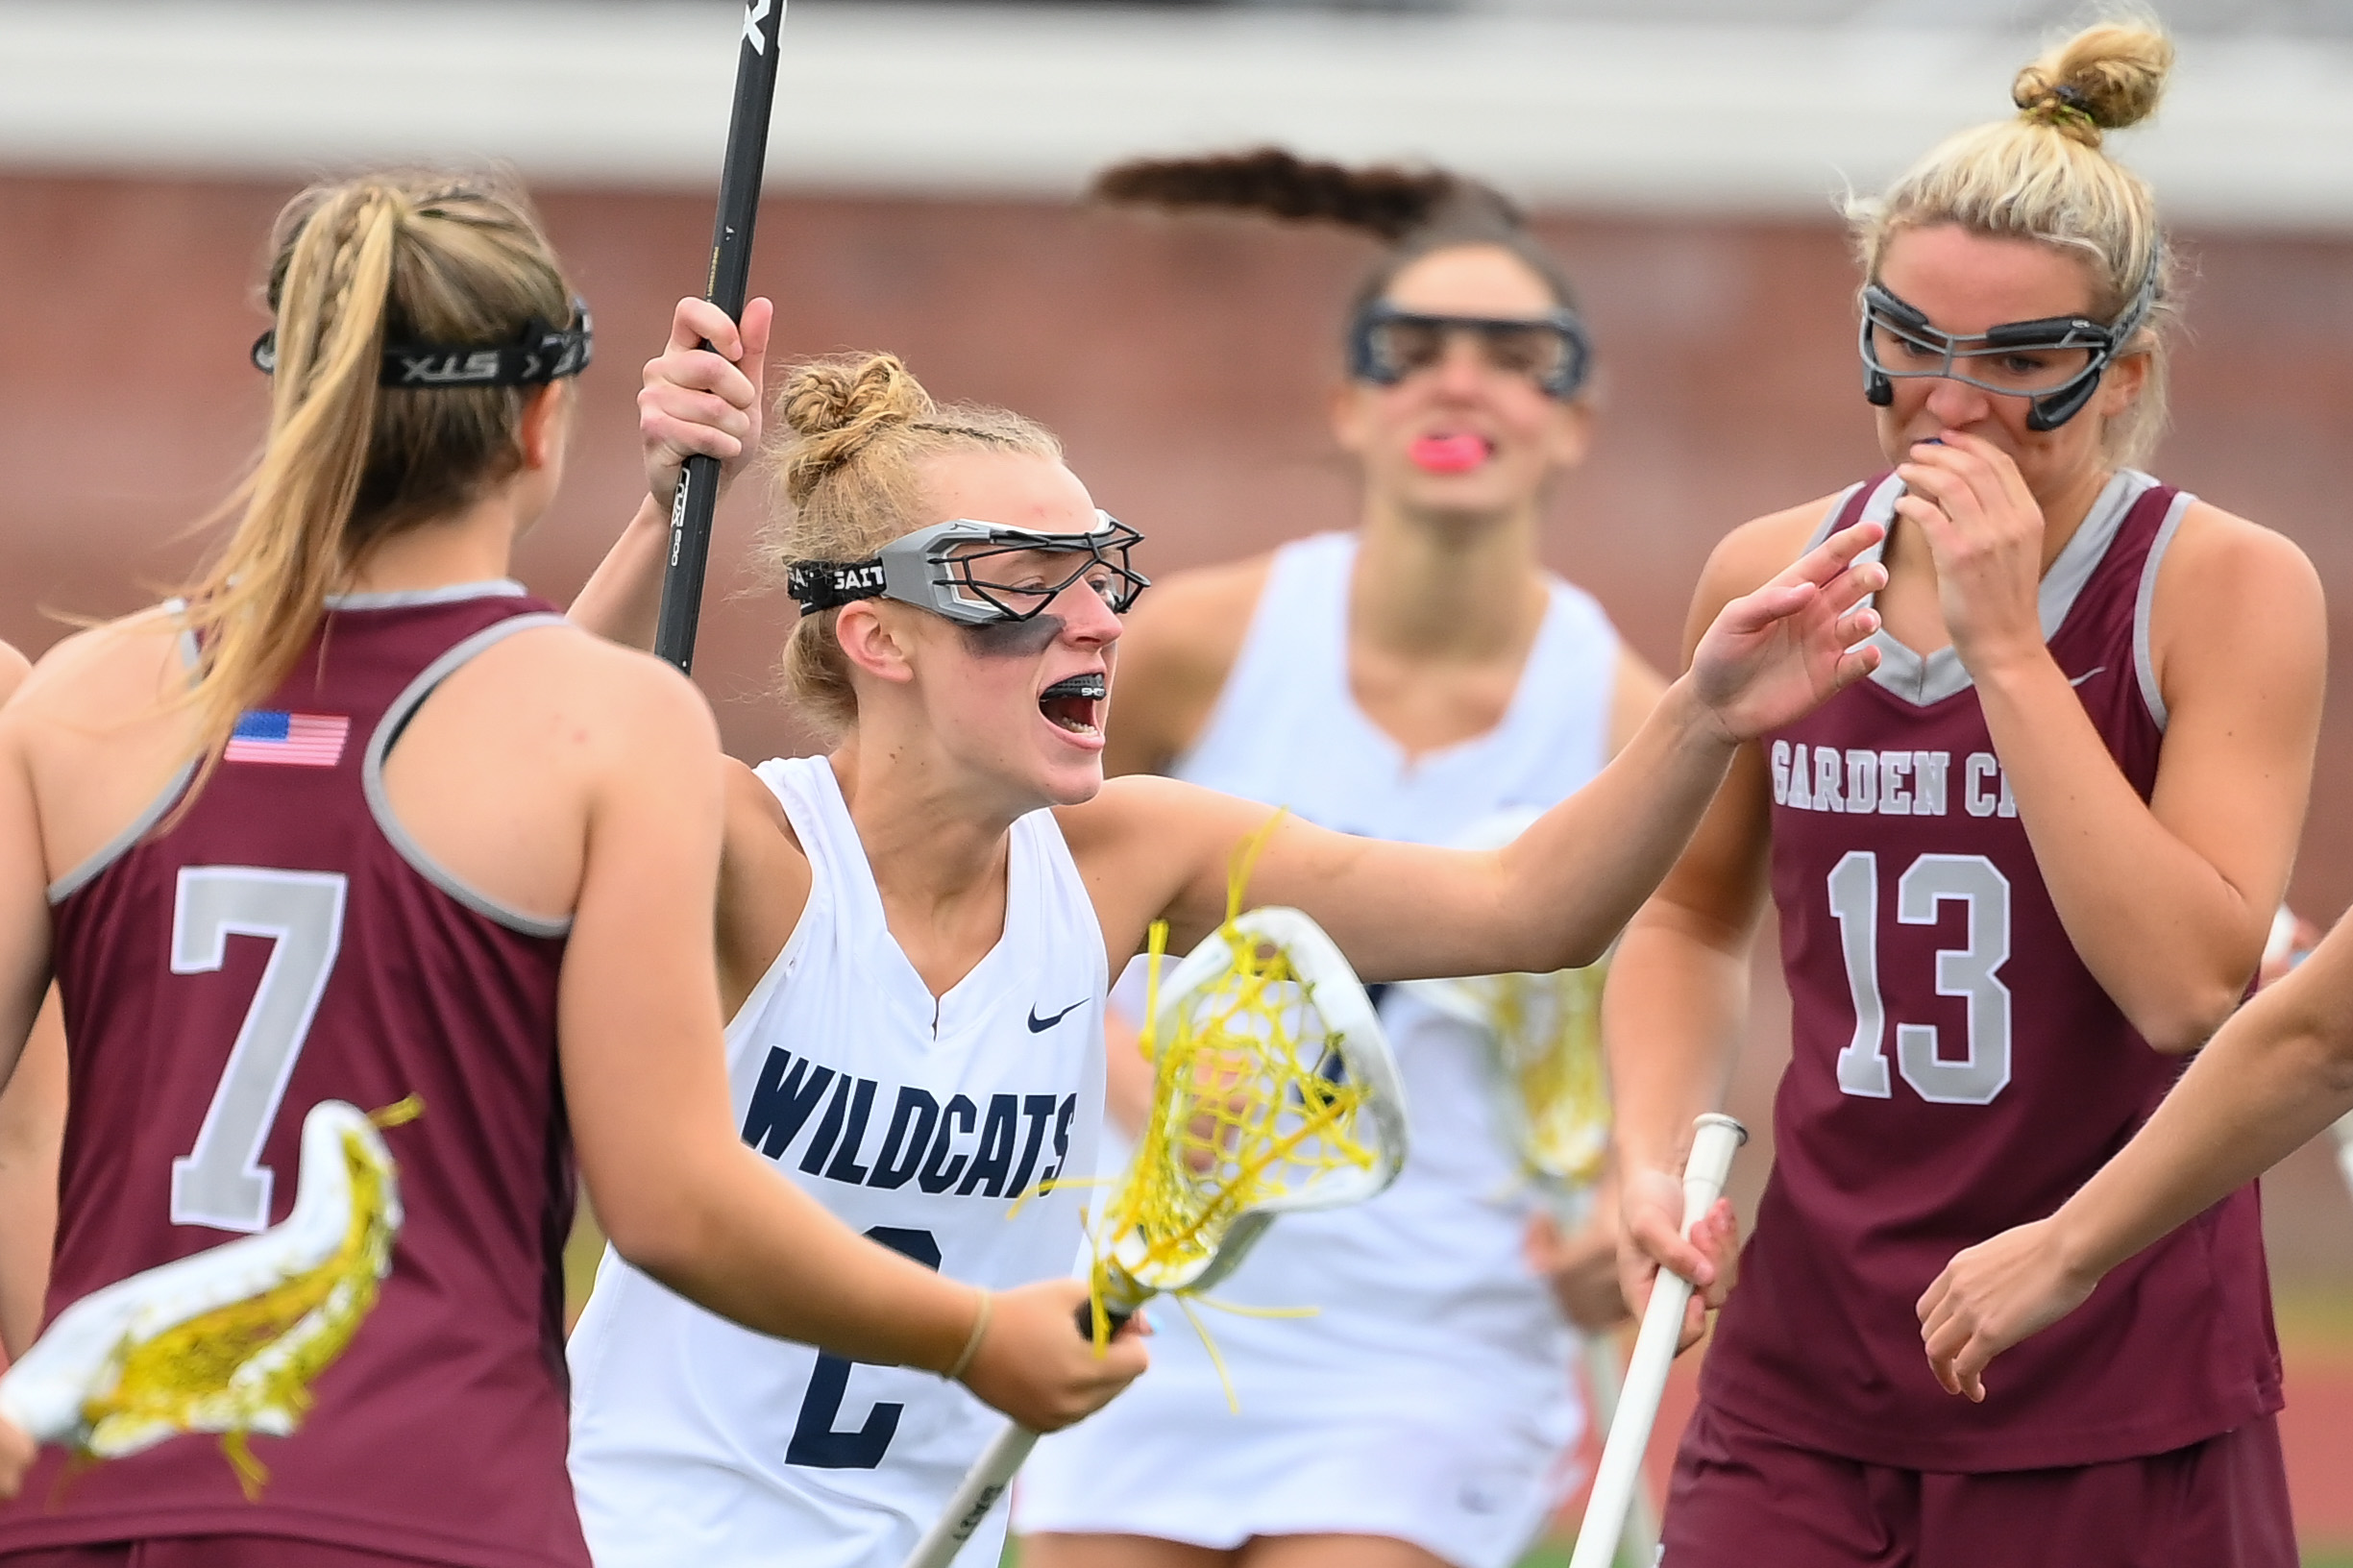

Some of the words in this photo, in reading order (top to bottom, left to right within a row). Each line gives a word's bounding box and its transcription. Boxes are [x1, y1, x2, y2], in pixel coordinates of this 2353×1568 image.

[1771, 739, 1950, 816] GARDEN
[1965, 751, 2017, 818] CI
[169, 866, 348, 1232] 7
[1827, 850, 2011, 1105] 13
[740, 1044, 1078, 1199] WILDCATS
